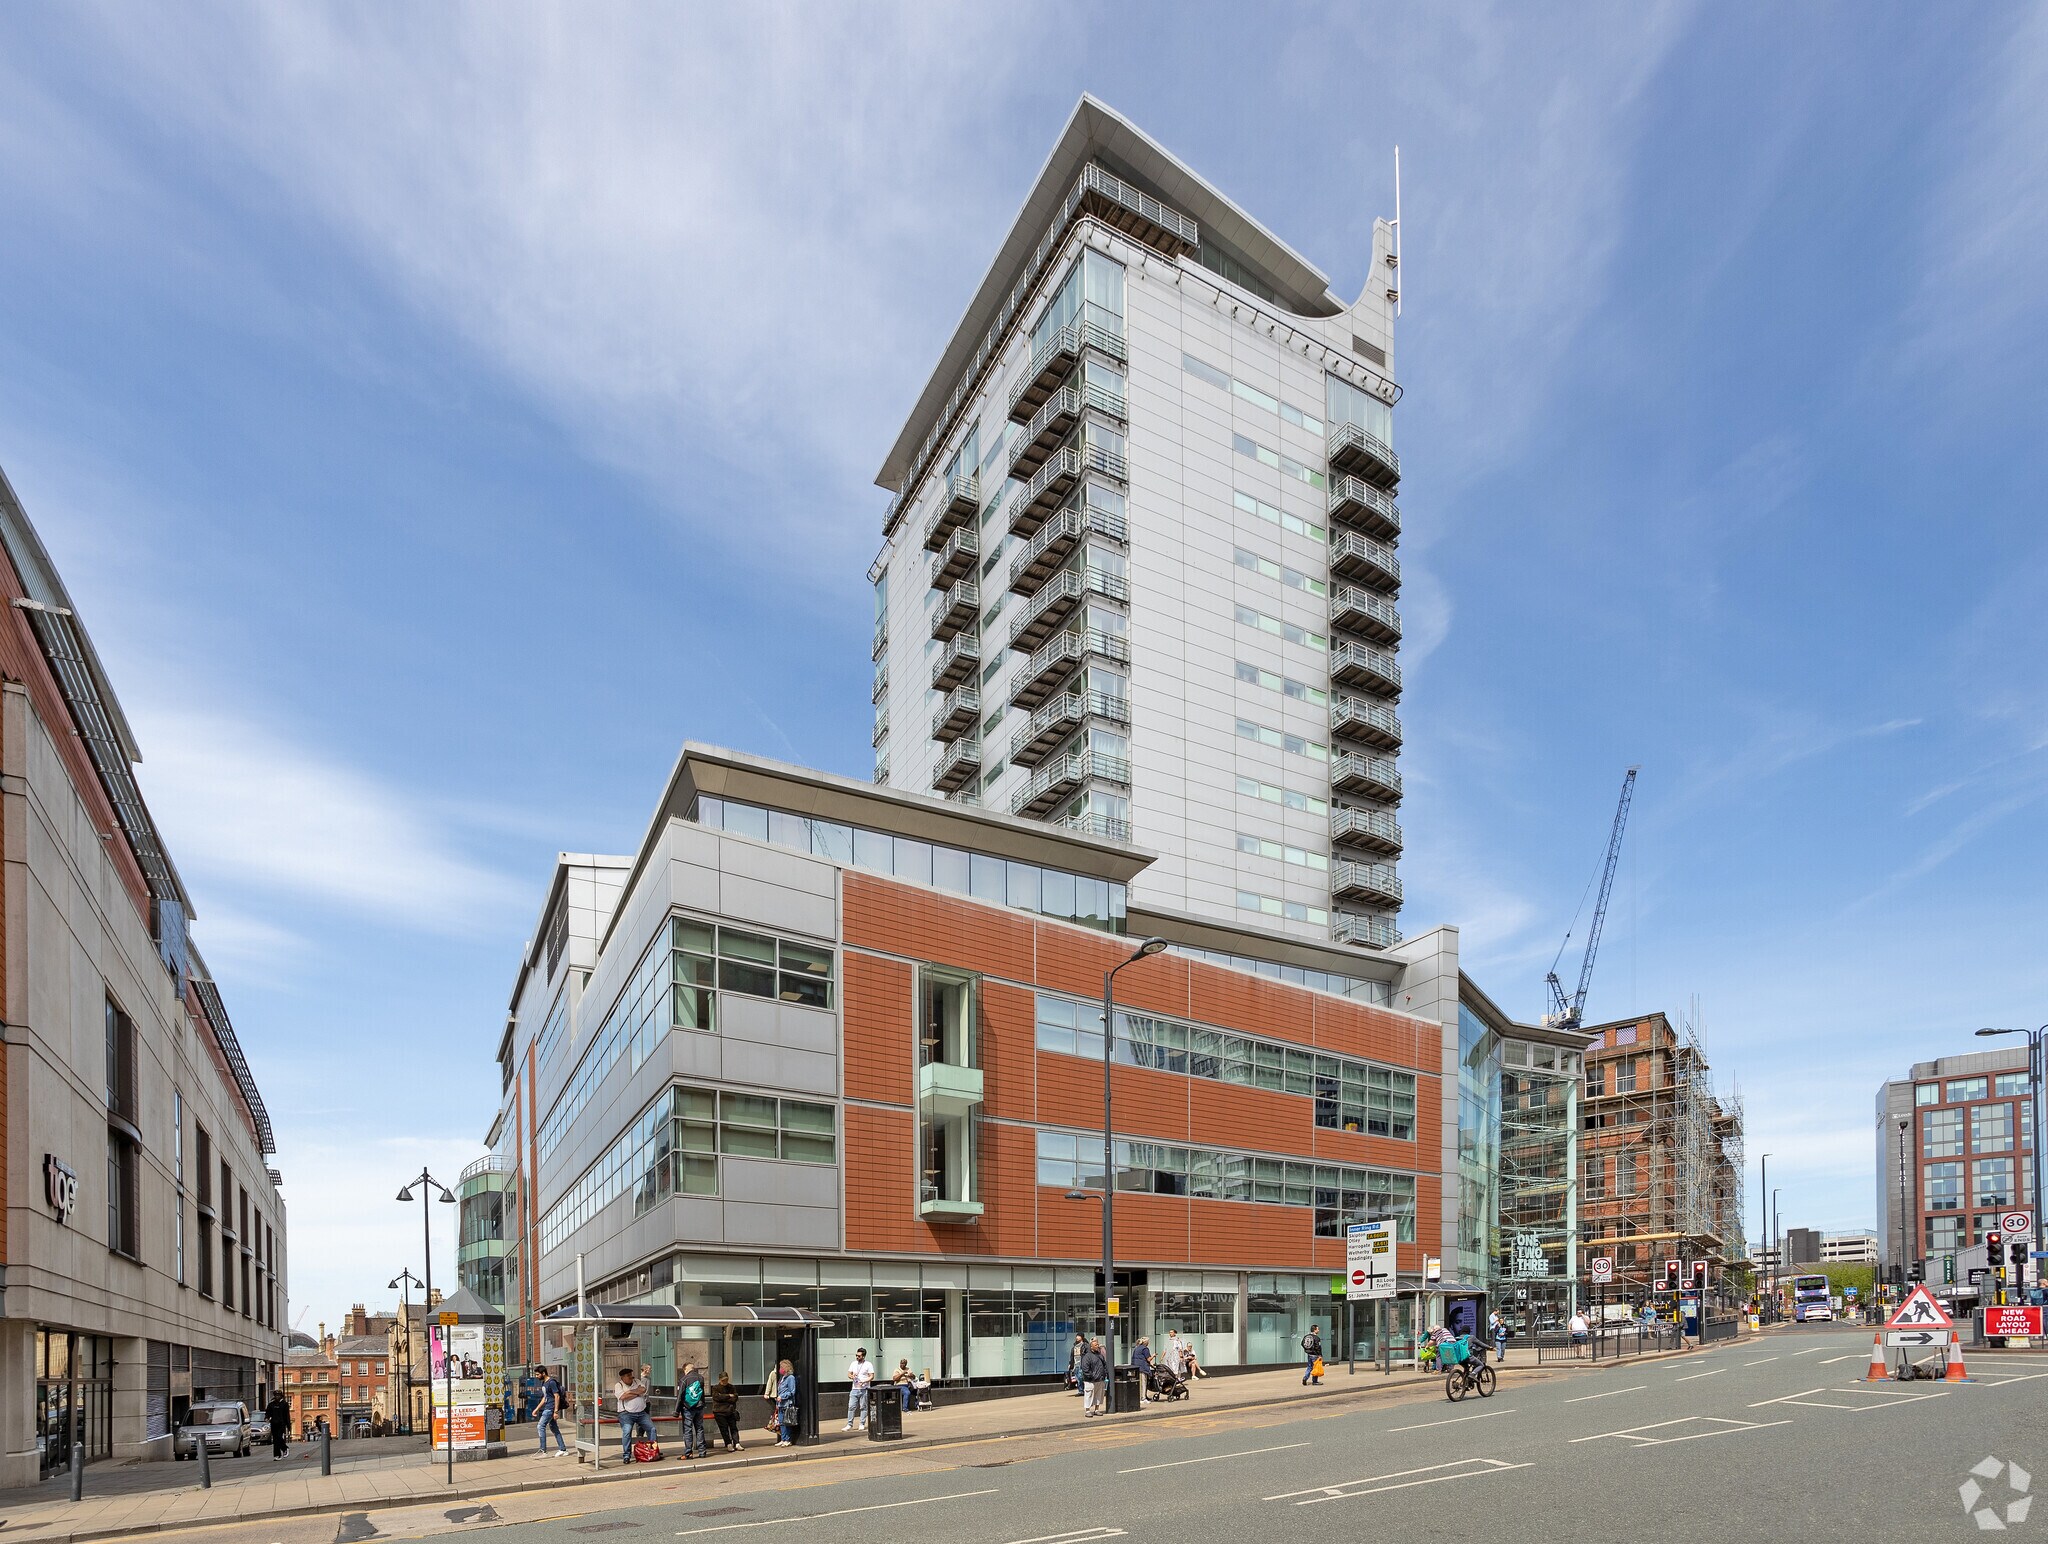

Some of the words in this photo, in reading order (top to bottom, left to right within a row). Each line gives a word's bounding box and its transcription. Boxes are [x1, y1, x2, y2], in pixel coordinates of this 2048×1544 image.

[2006, 1218, 2026, 1227] 30
[1516, 1233, 1540, 1246] ONE
[1517, 1246, 1543, 1259] TWO
[1517, 1258, 1549, 1271] THREE
[1596, 1262, 1608, 1270] 30
[1517, 1289, 1527, 1298] K2
